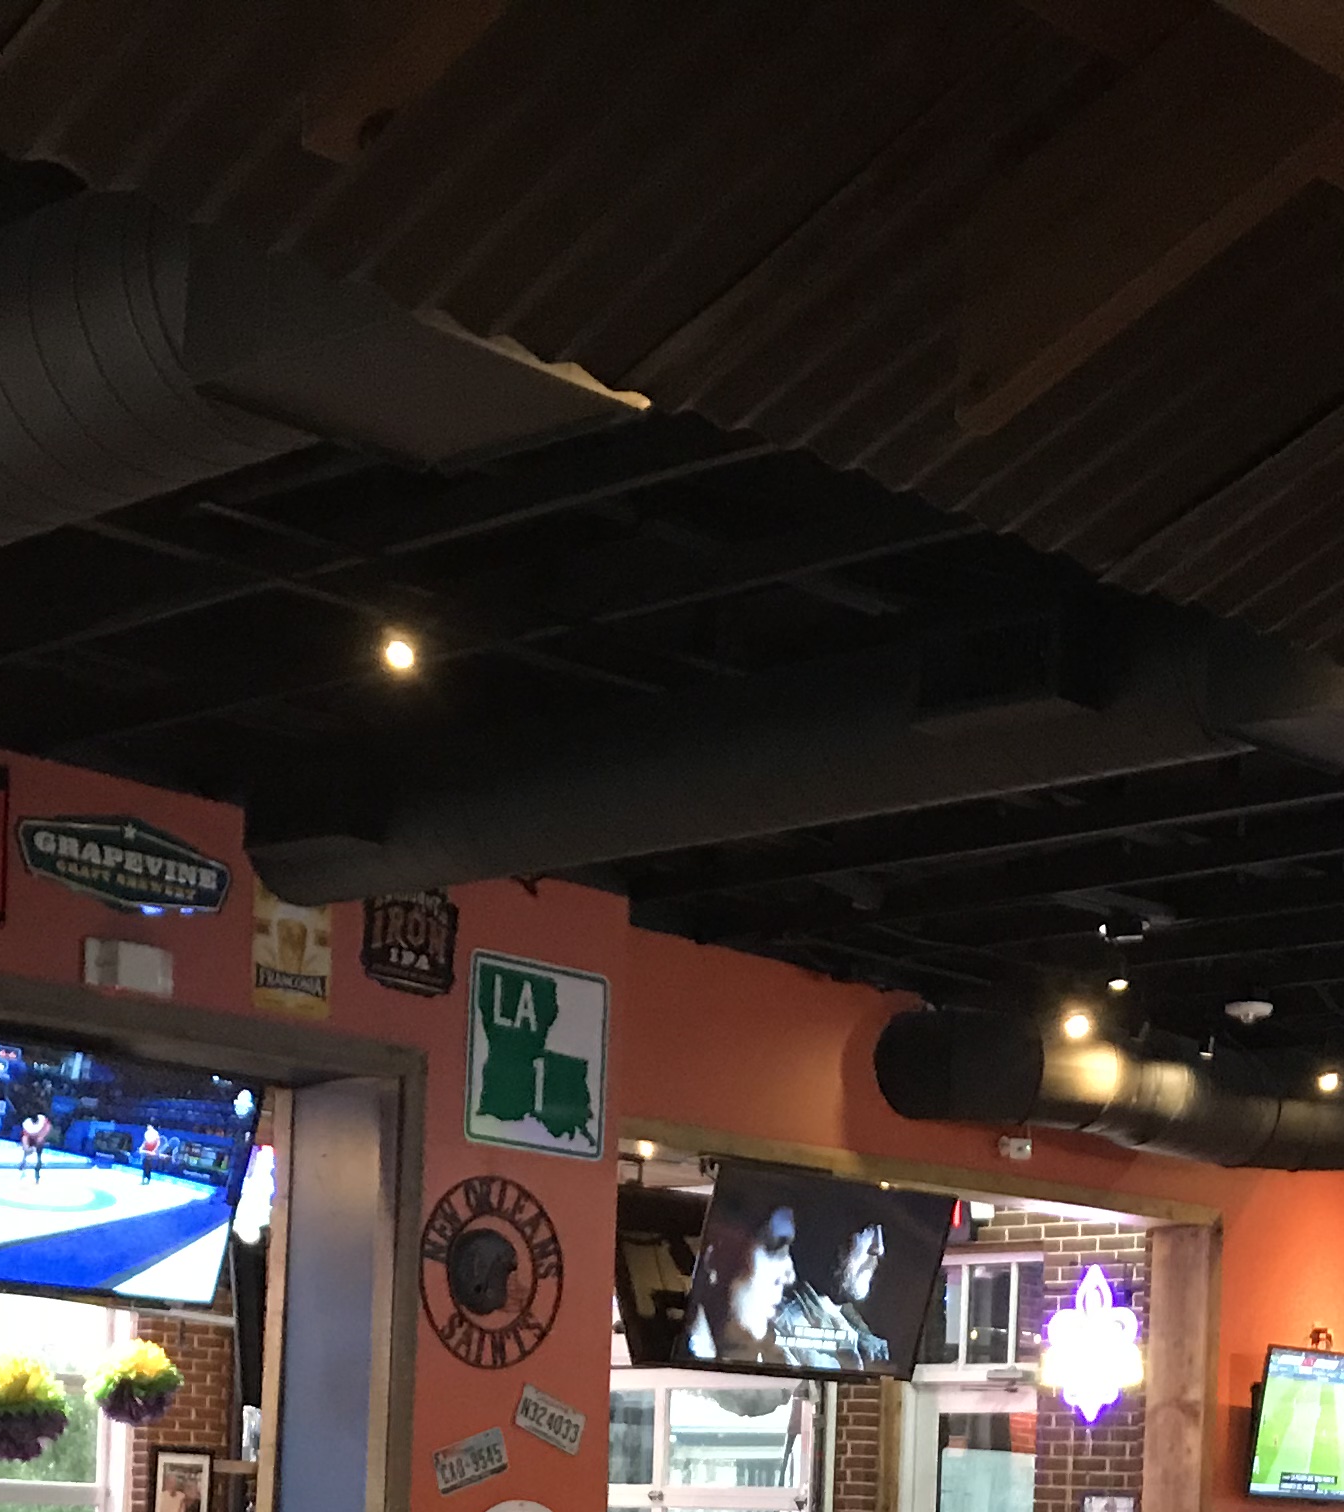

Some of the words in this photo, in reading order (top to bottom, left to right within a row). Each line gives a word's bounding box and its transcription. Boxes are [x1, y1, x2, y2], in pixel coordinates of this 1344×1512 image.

[33, 830, 218, 890] GRAPEVINE
[492, 974, 538, 1033] LA
[532, 1056, 546, 1113] 1
[423, 1199, 462, 1263] NEW
[464, 1179, 561, 1279] ORLEANS
[439, 1312, 545, 1366] SAINTS
